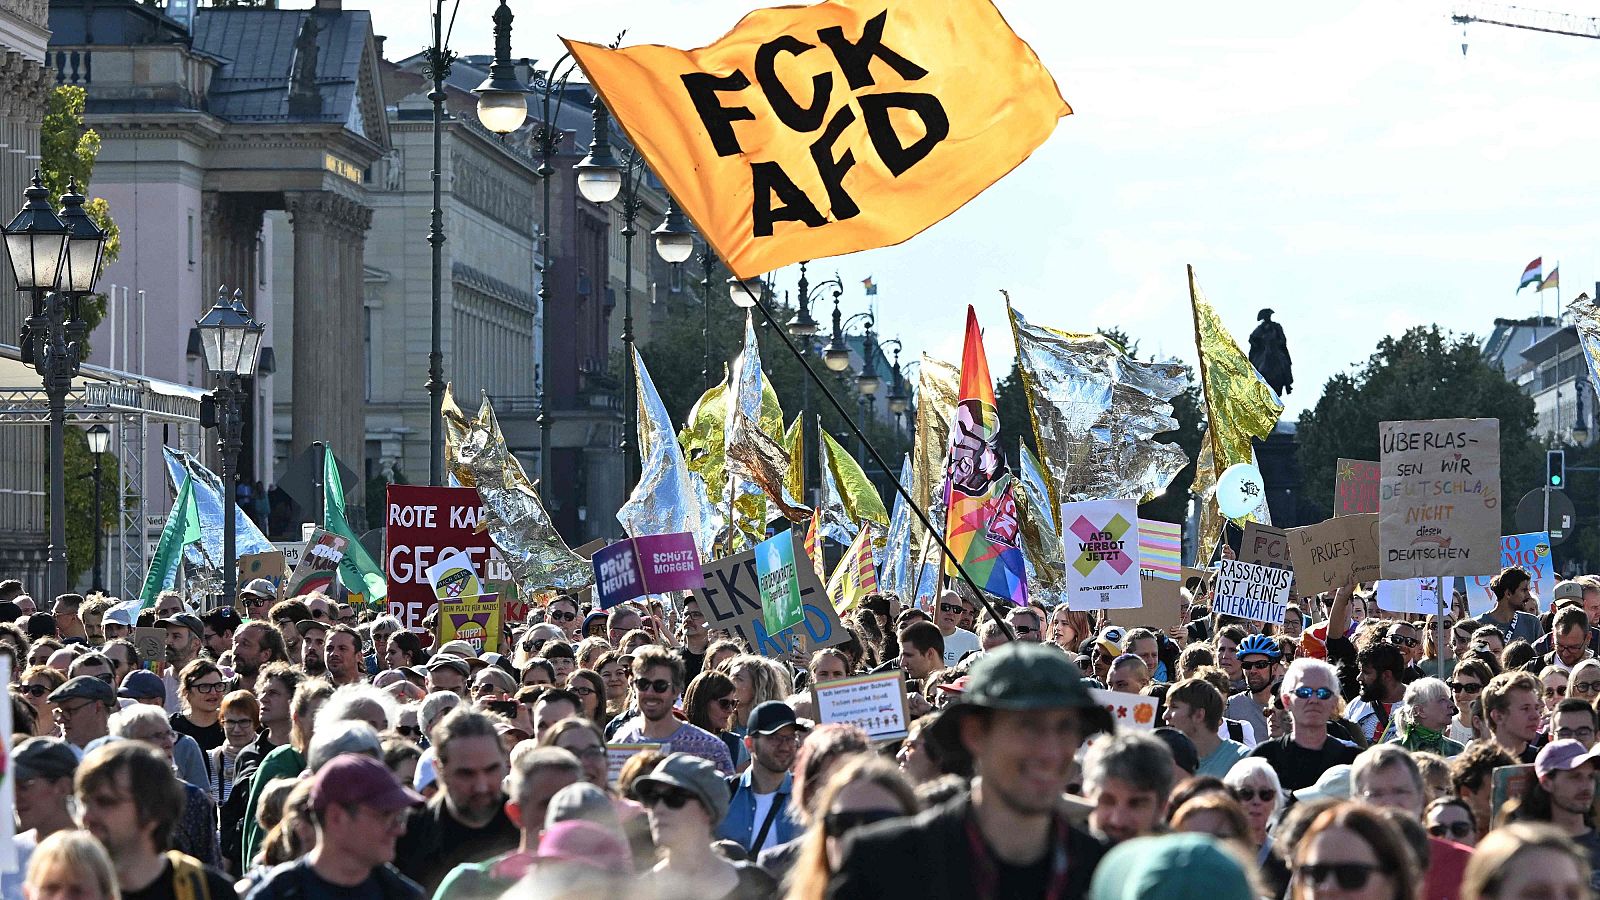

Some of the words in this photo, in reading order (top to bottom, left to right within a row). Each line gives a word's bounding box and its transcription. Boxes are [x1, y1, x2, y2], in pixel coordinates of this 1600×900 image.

[680, 8, 929, 157] FCK
[750, 92, 949, 237] AFD
[1383, 426, 1479, 454] ÜBERLAS-
[1397, 463, 1423, 476] SEN
[1382, 480, 1497, 509] DEUTSCHLAND
[389, 504, 437, 528] ROTE
[1089, 532, 1113, 541] AFD
[1416, 525, 1442, 537] diesen
[1079, 541, 1125, 551] VERBOT
[1310, 538, 1355, 565] PRÜFST
[1388, 548, 1470, 562] DEUTSCHEN
[600, 550, 633, 581] PRÜF
[653, 550, 694, 563] SCHÜTZ
[1086, 551, 1120, 561] JETZT
[654, 561, 695, 574] MORGEN
[1220, 560, 1289, 589] RASSISMUS
[602, 569, 635, 596] HEUTE
[1080, 584, 1128, 592] AFD-VERBOT.JETZT
[1218, 579, 1240, 595] IST
[1246, 583, 1281, 604] KEINE
[443, 604, 454, 612] KEIN
[472, 603, 480, 611] FÜR
[483, 603, 498, 611] NAZIS!
[1214, 594, 1286, 623] ALTERNATIVE
[456, 628, 482, 640] STOPPT
